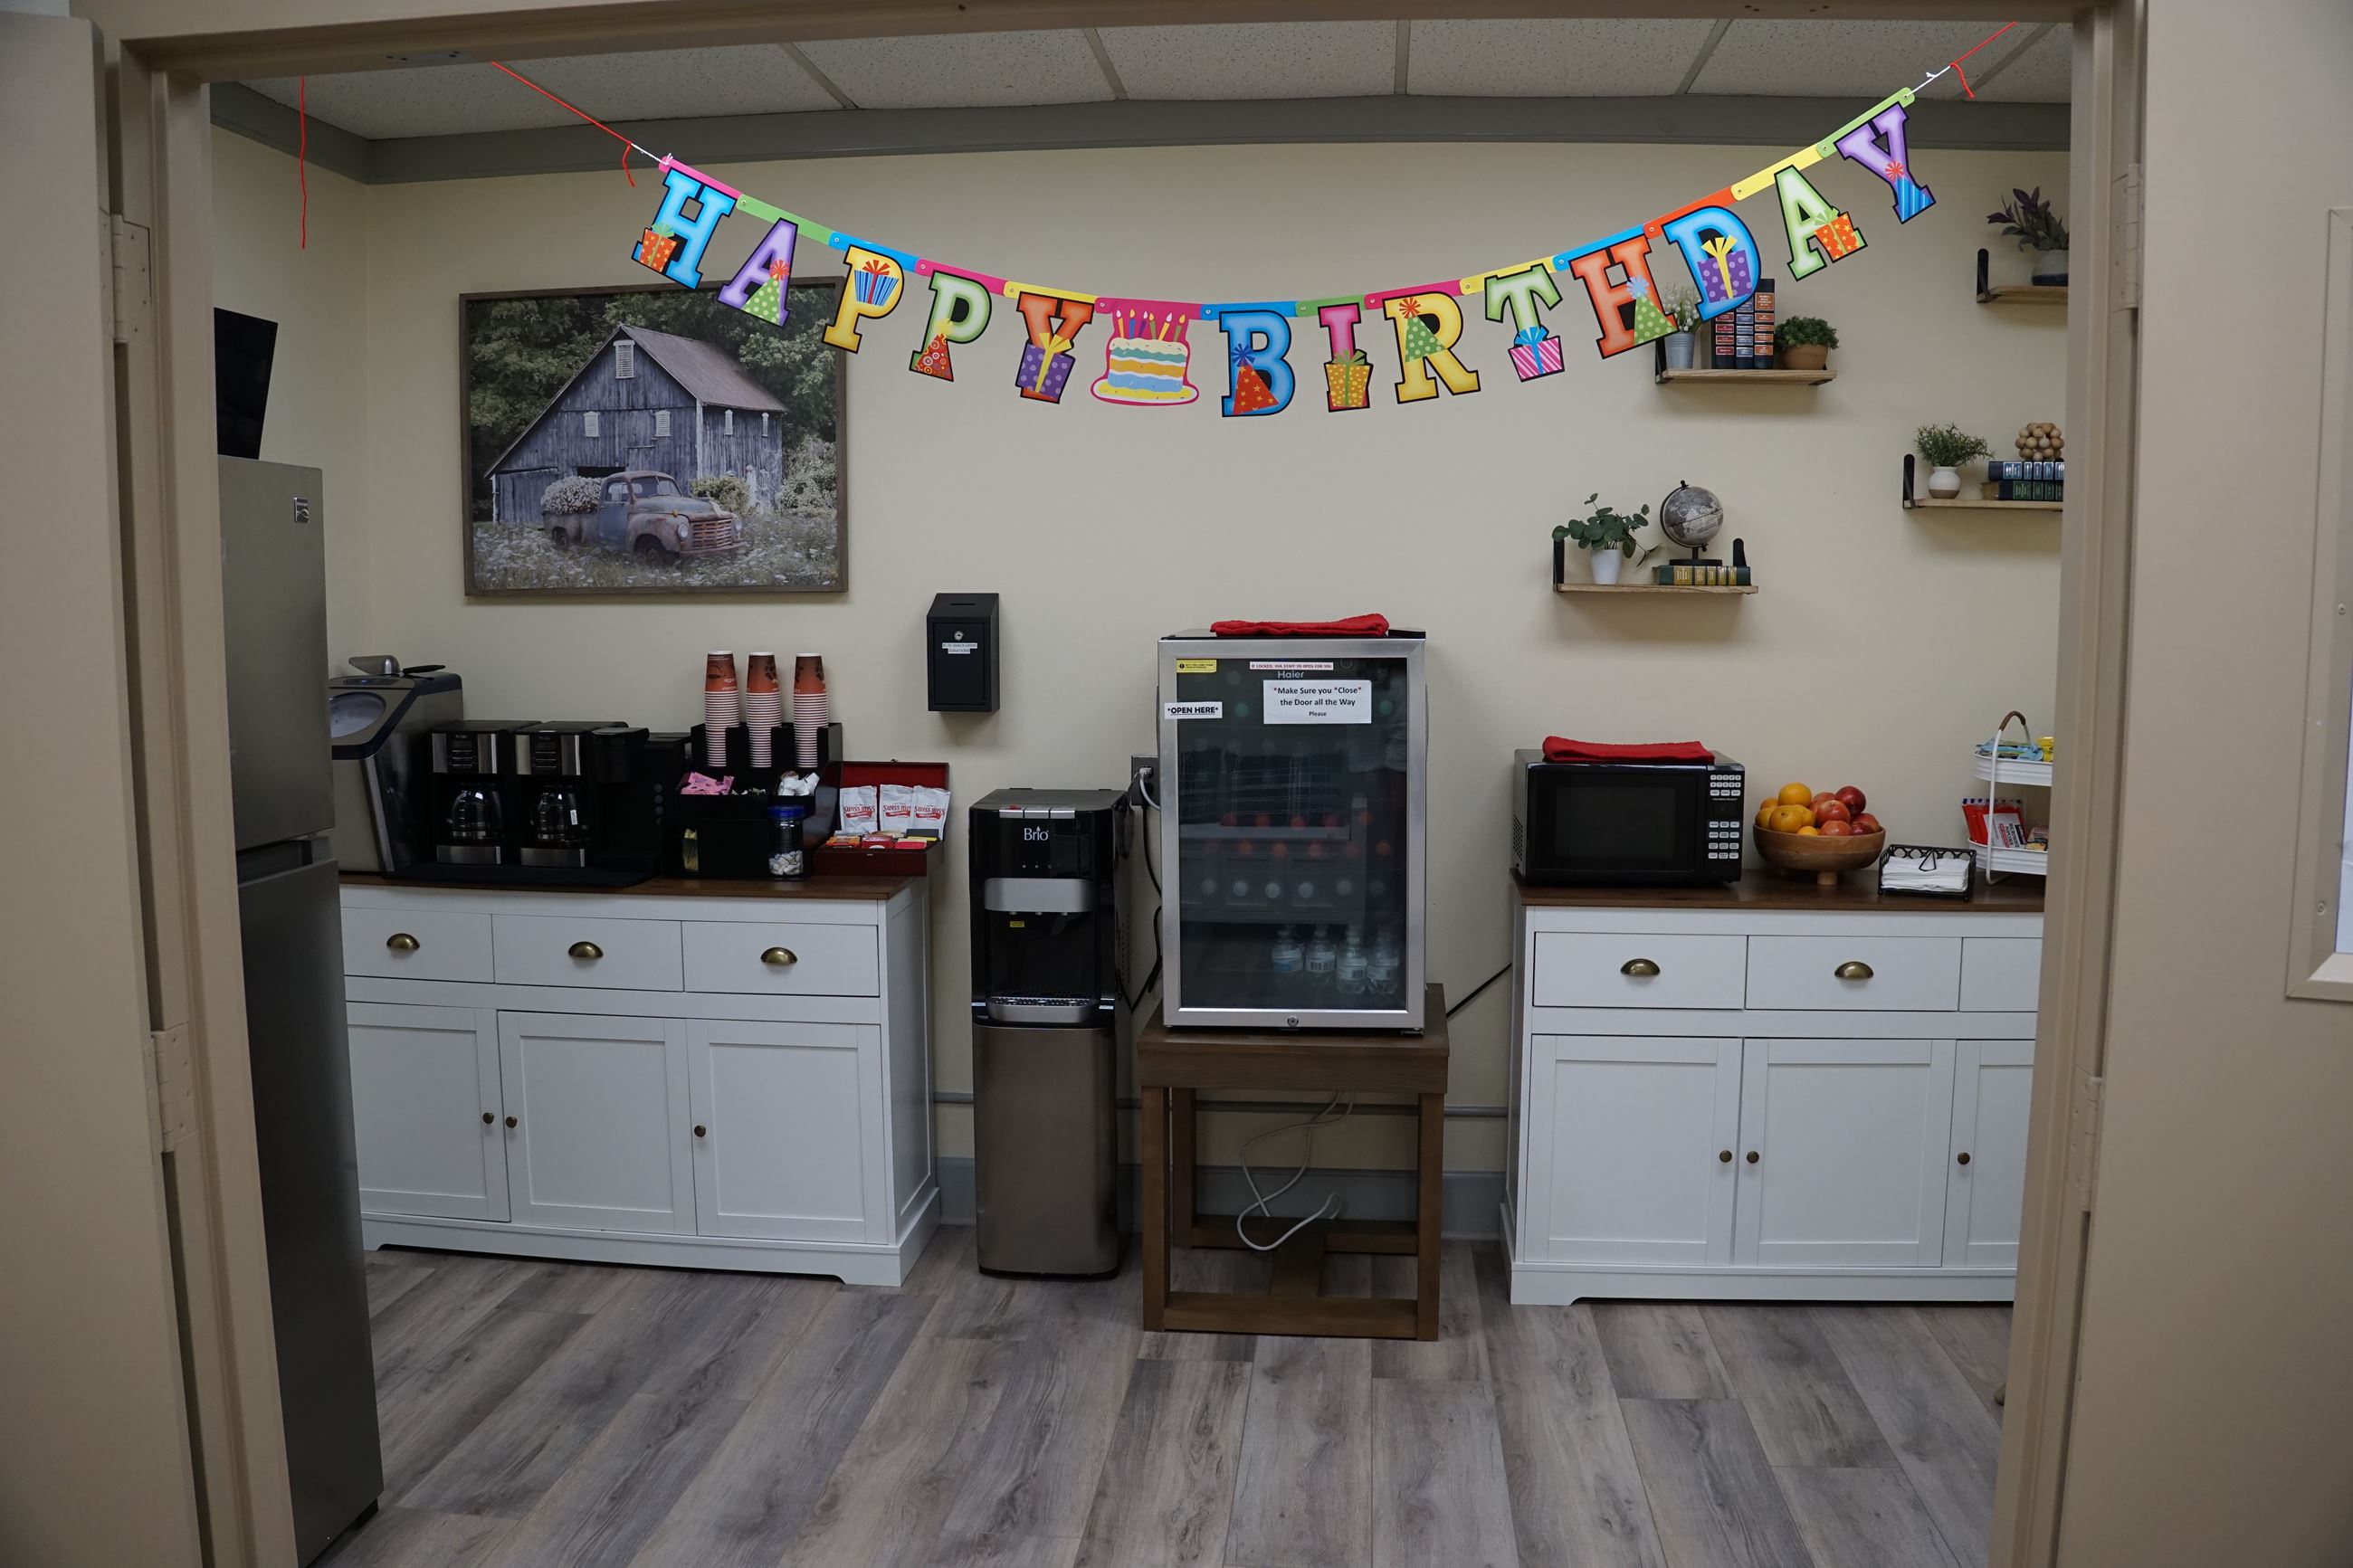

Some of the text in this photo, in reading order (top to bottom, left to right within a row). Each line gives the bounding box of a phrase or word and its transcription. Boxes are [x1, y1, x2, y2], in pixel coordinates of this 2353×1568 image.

[631, 101, 1936, 417] HAPPY BIRTHDAY
[1277, 670, 1304, 679] Haier
[1339, 698, 1356, 707] Way
[1024, 826, 1049, 841] Brio
